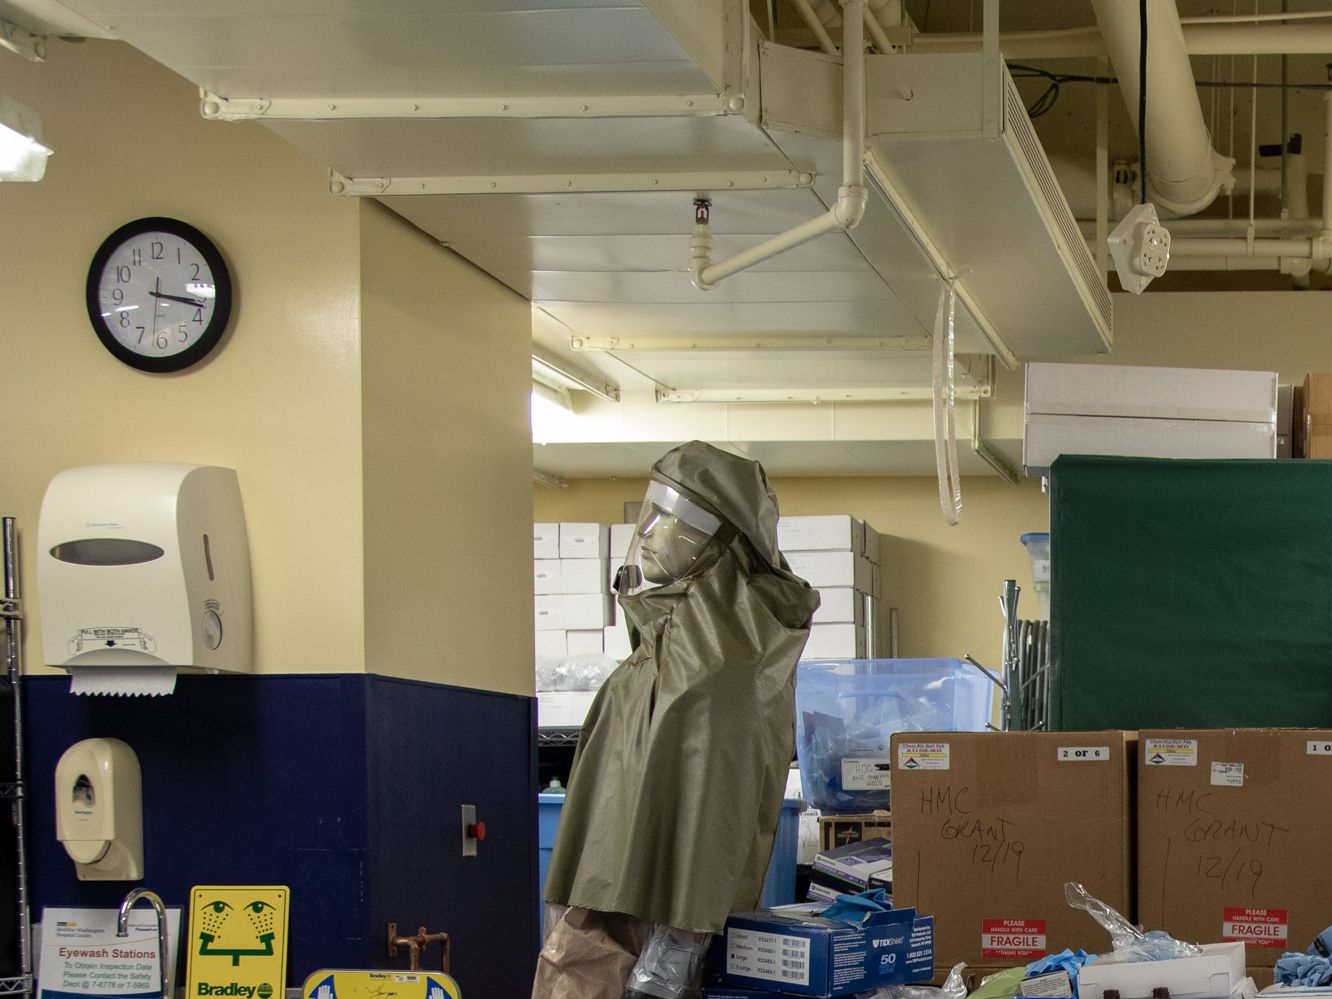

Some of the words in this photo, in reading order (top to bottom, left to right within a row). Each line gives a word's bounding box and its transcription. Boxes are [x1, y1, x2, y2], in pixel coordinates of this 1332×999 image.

[132, 248, 142, 266] 11
[151, 242, 164, 260] 12
[116, 265, 132, 283] 10
[190, 263, 200, 281] 2
[112, 288, 124, 306] 9
[120, 311, 131, 329] 8
[192, 308, 204, 325] 4
[136, 326, 146, 344] 7
[157, 331, 168, 349] 6
[178, 325, 188, 342] 5
[921, 786, 972, 814] HMC
[1156, 787, 1212, 813] HMC
[941, 817, 1015, 841] GRANT
[1184, 819, 1289, 846] GRANT
[972, 840, 1024, 884] 12/19
[1197, 847, 1263, 900] 12/19
[1231, 924, 1279, 936] FRAGILE
[990, 936, 1038, 947] FRAGILE
[59, 947, 109, 959] Eyewash
[112, 948, 156, 959] Stations
[880, 953, 896, 964] 50
[63, 971, 87, 979] Please
[130, 973, 152, 981] Safety
[100, 963, 135, 971] Inspection
[63, 981, 80, 989] Dept
[81, 981, 90, 989] @
[197, 982, 256, 999] Bradley
